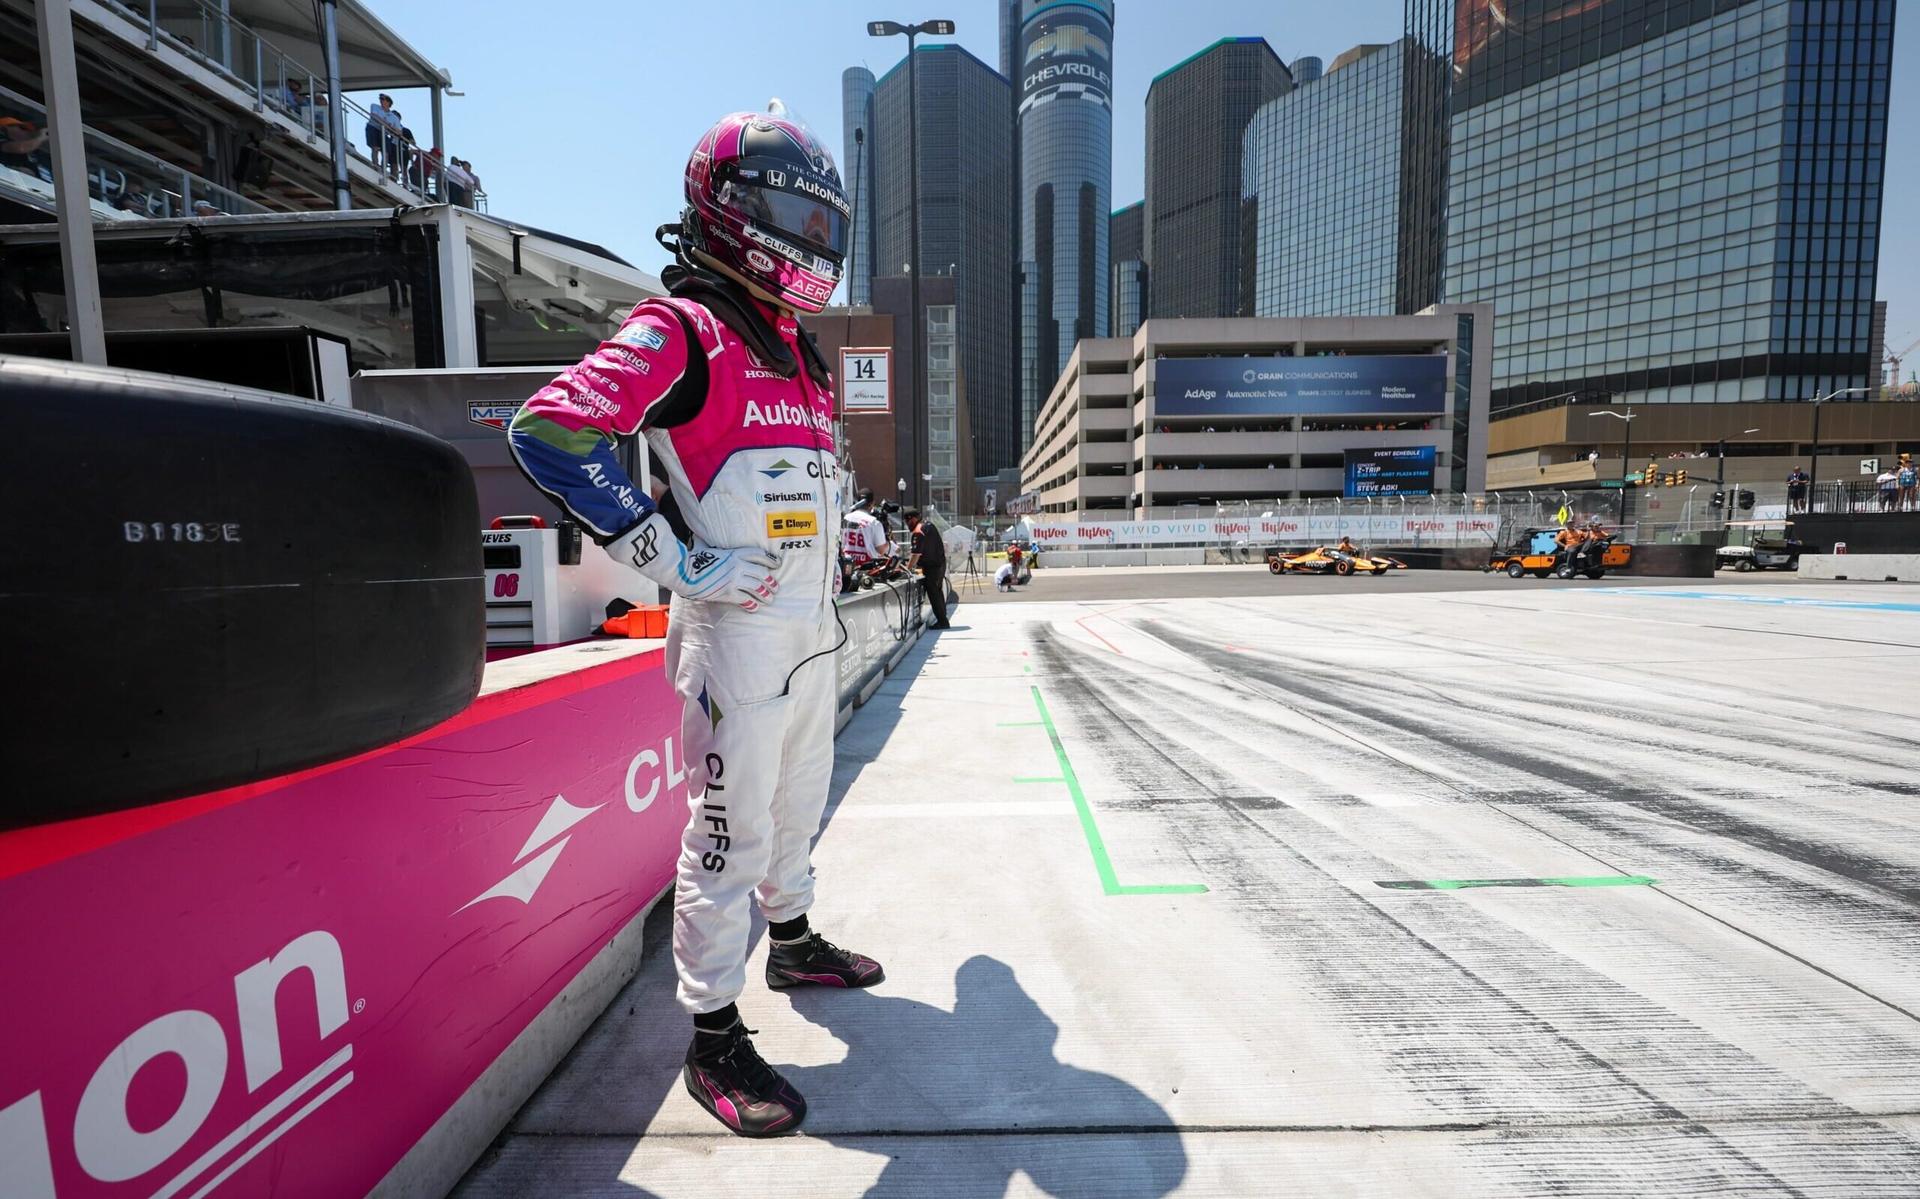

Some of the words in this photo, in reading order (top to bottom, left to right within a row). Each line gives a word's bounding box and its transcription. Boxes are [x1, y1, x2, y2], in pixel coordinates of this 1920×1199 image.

[764, 237, 801, 260] CLIFFS
[750, 252, 770, 269] BELL
[816, 261, 832, 276] UP
[854, 358, 876, 379] 14
[1257, 372, 1284, 380] CRAIN
[1285, 371, 1358, 380] COMMUNICATIONS
[1184, 388, 1216, 400] AdAge
[1225, 389, 1267, 399] Automotive
[1267, 389, 1287, 398] News
[785, 519, 812, 528] Clopay
[1122, 525, 1161, 535] VIVID
[1167, 524, 1206, 535] VIVID
[494, 573, 520, 598] 06
[702, 752, 731, 874] CLIFFS
